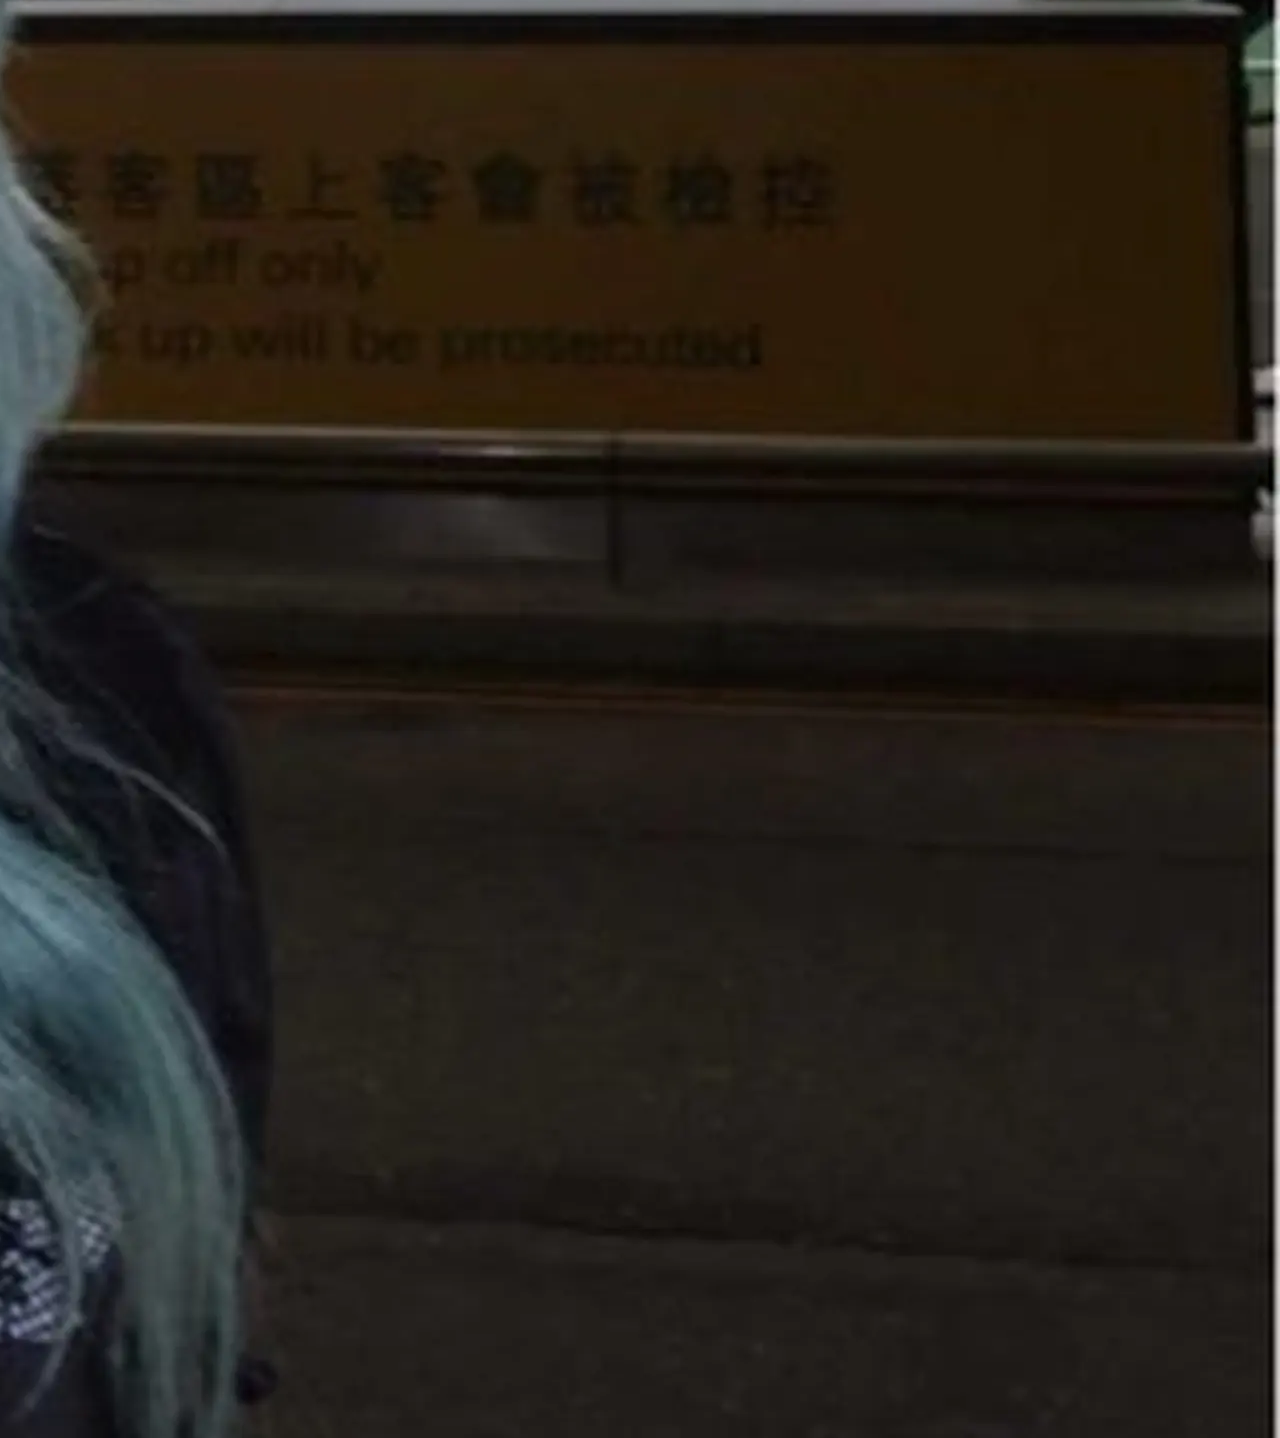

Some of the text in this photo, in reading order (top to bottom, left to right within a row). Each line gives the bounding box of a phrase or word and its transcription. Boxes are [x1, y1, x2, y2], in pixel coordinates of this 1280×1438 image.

[162, 238, 239, 286] off
[259, 239, 383, 293] only
[141, 324, 215, 368] up
[231, 318, 328, 361] will
[350, 320, 422, 364] be
[438, 322, 762, 376] prosecuted
